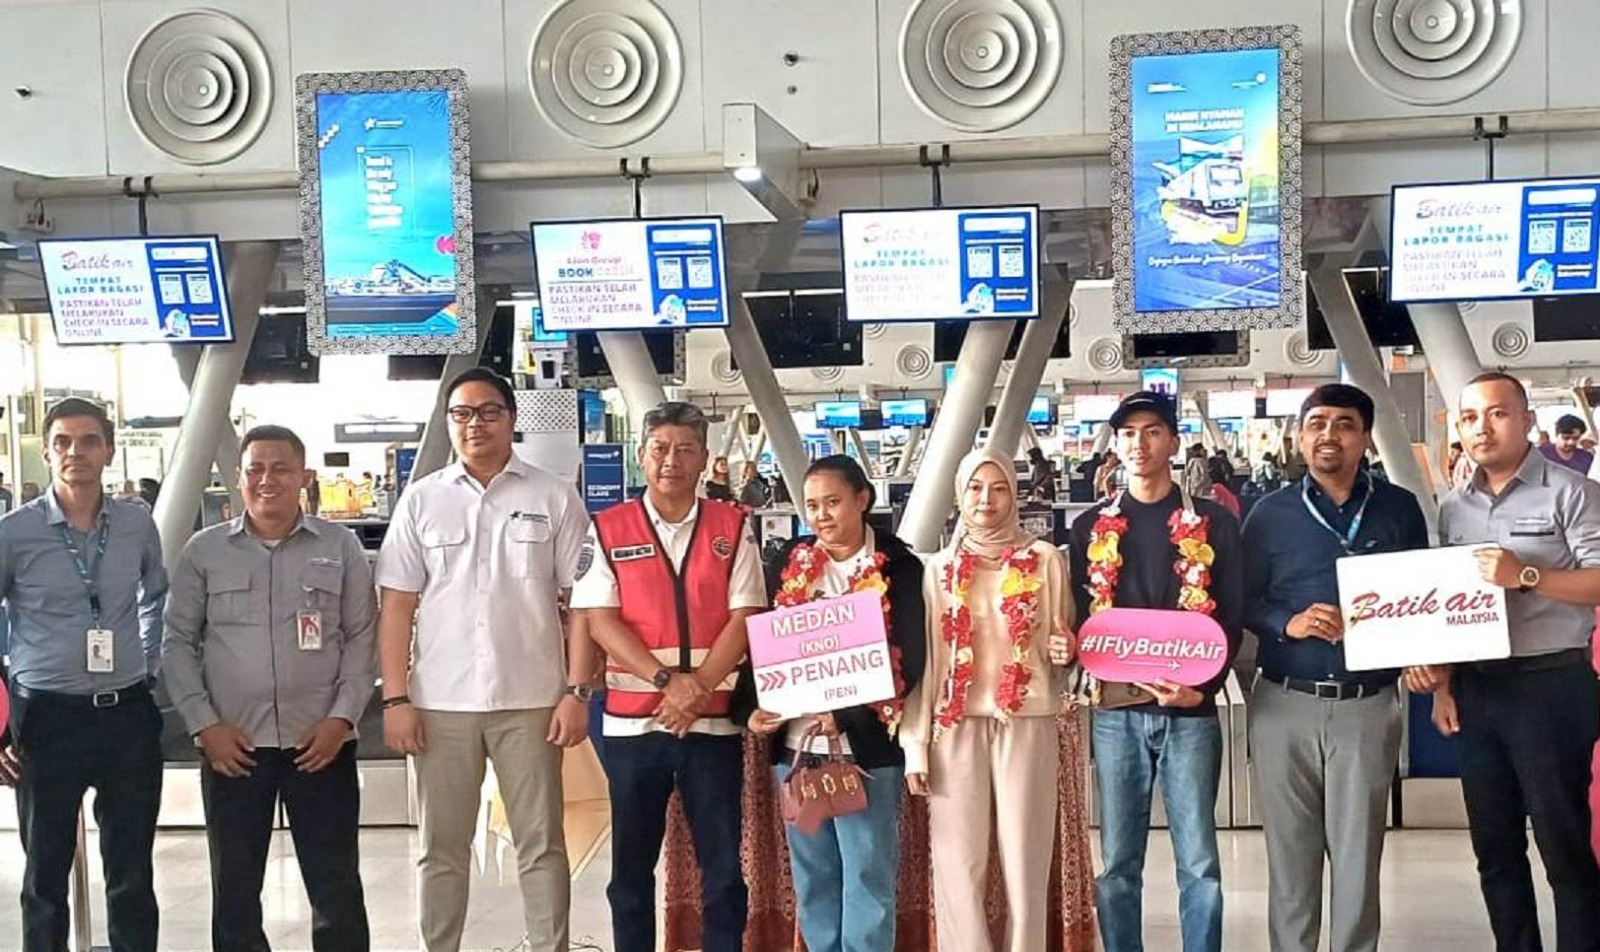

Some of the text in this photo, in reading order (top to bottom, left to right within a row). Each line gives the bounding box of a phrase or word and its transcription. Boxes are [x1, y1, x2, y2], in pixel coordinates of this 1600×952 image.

[1416, 199, 1474, 219] Batik
[1429, 224, 1483, 234] TEMPAT
[1403, 233, 1508, 246] LAPOR BAGASI
[61, 250, 110, 271] Batik
[566, 257, 590, 265] Lion
[558, 267, 593, 278] BOOK
[75, 276, 121, 285] TEMPAT
[57, 285, 143, 295] LAPOR BAGASI
[548, 282, 637, 294] PASTIKAN TELAH
[59, 298, 142, 308] PASTIKAN TELAH
[602, 303, 642, 313] SECARA
[1349, 587, 1497, 625] Batik air
[771, 603, 855, 638] MEDAN
[1446, 611, 1500, 627] MALAYSIA
[800, 635, 840, 657] (KNO)
[1080, 635, 1225, 660] #IFlyBatikAir
[790, 650, 884, 686] PENANG
[824, 685, 858, 701] (PEN)
